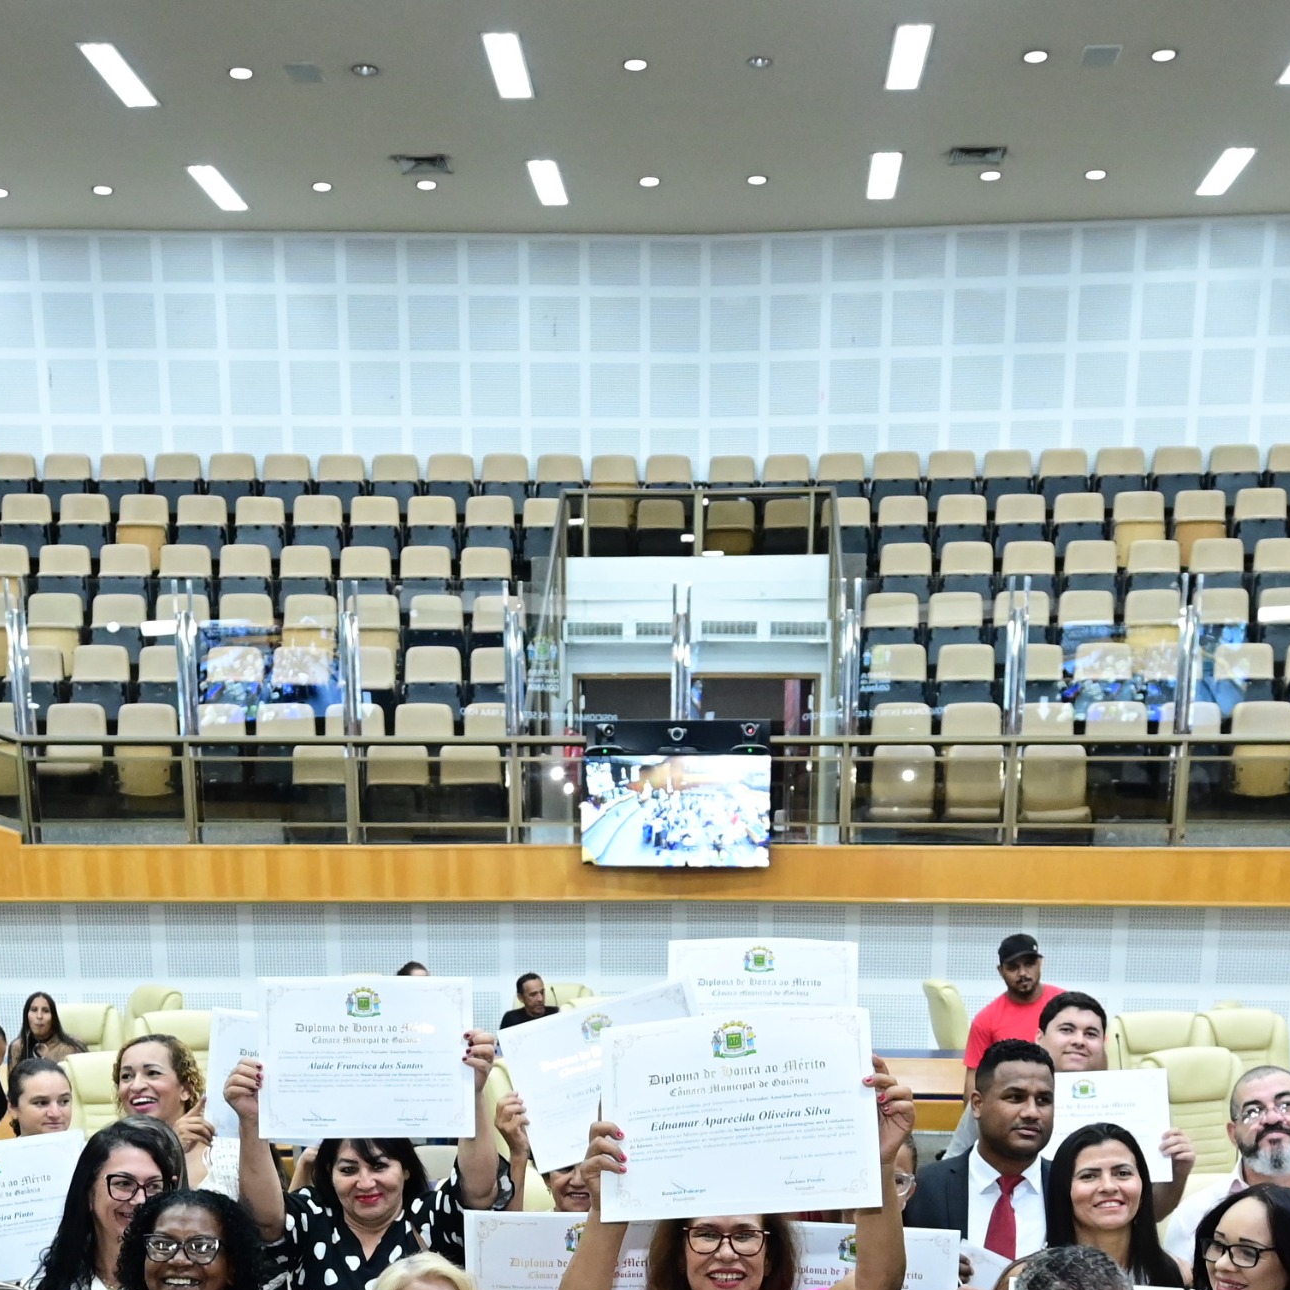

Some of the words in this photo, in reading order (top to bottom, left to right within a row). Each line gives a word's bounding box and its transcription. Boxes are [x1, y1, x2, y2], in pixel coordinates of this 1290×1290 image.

[336, 1061, 377, 1070] Francisca
[379, 1061, 394, 1070] dos
[395, 1061, 424, 1070] Santos
[648, 1071, 700, 1086] Diploma
[703, 1068, 717, 1080] de
[764, 1064, 778, 1074] ao
[782, 1058, 826, 1074] Mérito
[650, 1115, 700, 1132] Ednamar
[701, 1112, 755, 1128] Aparecida
[758, 1108, 801, 1121] Oliveira
[804, 1106, 831, 1117] Silva
[14, 1211, 34, 1219] Pinto
